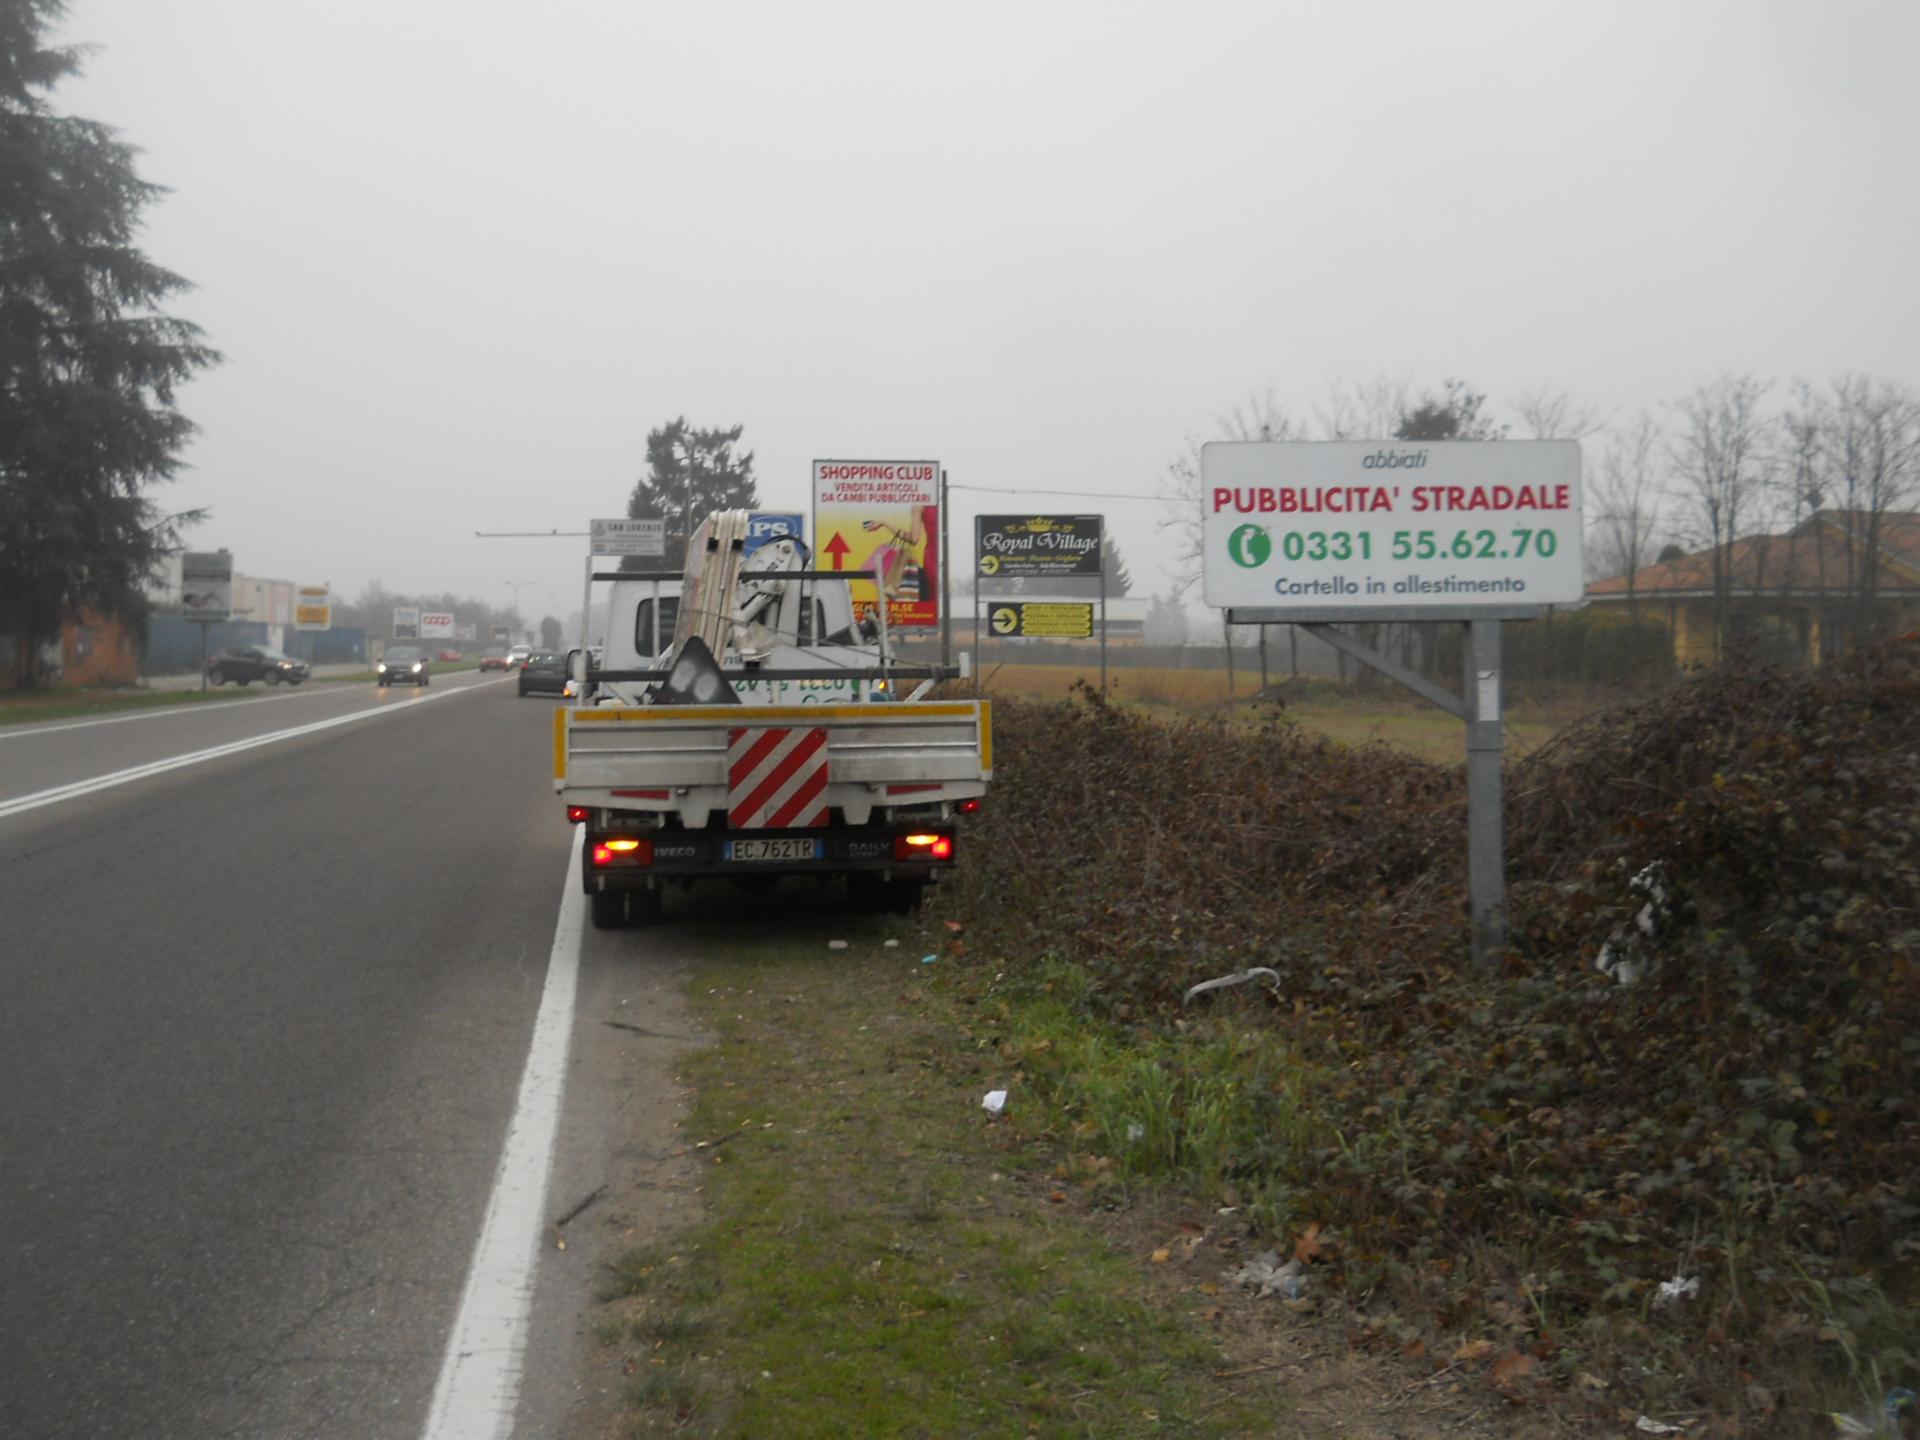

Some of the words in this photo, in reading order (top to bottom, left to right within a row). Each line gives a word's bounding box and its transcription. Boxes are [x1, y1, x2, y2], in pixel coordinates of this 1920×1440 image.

[1362, 449, 1429, 470] abbiati
[820, 465, 894, 480] SHOPPING
[897, 466, 933, 480] CLUB
[821, 493, 835, 502] DA
[836, 493, 867, 502] CAMBI
[834, 482, 875, 492] VENDITA
[876, 482, 918, 493] ARTICOLI
[1213, 486, 1400, 514] PUBBLICITA'
[1412, 485, 1570, 512] STRADALE
[983, 532, 1034, 555] Royal
[1037, 531, 1098, 555] Village
[1283, 532, 1372, 561] 0331
[1392, 529, 1558, 560] 55.62.70
[1275, 577, 1359, 595] Cartello
[1366, 577, 1386, 594] in
[1393, 574, 1526, 594] allestimento
[653, 846, 696, 857] IVECO
[734, 841, 754, 859] EC
[760, 838, 812, 858] 762TR
